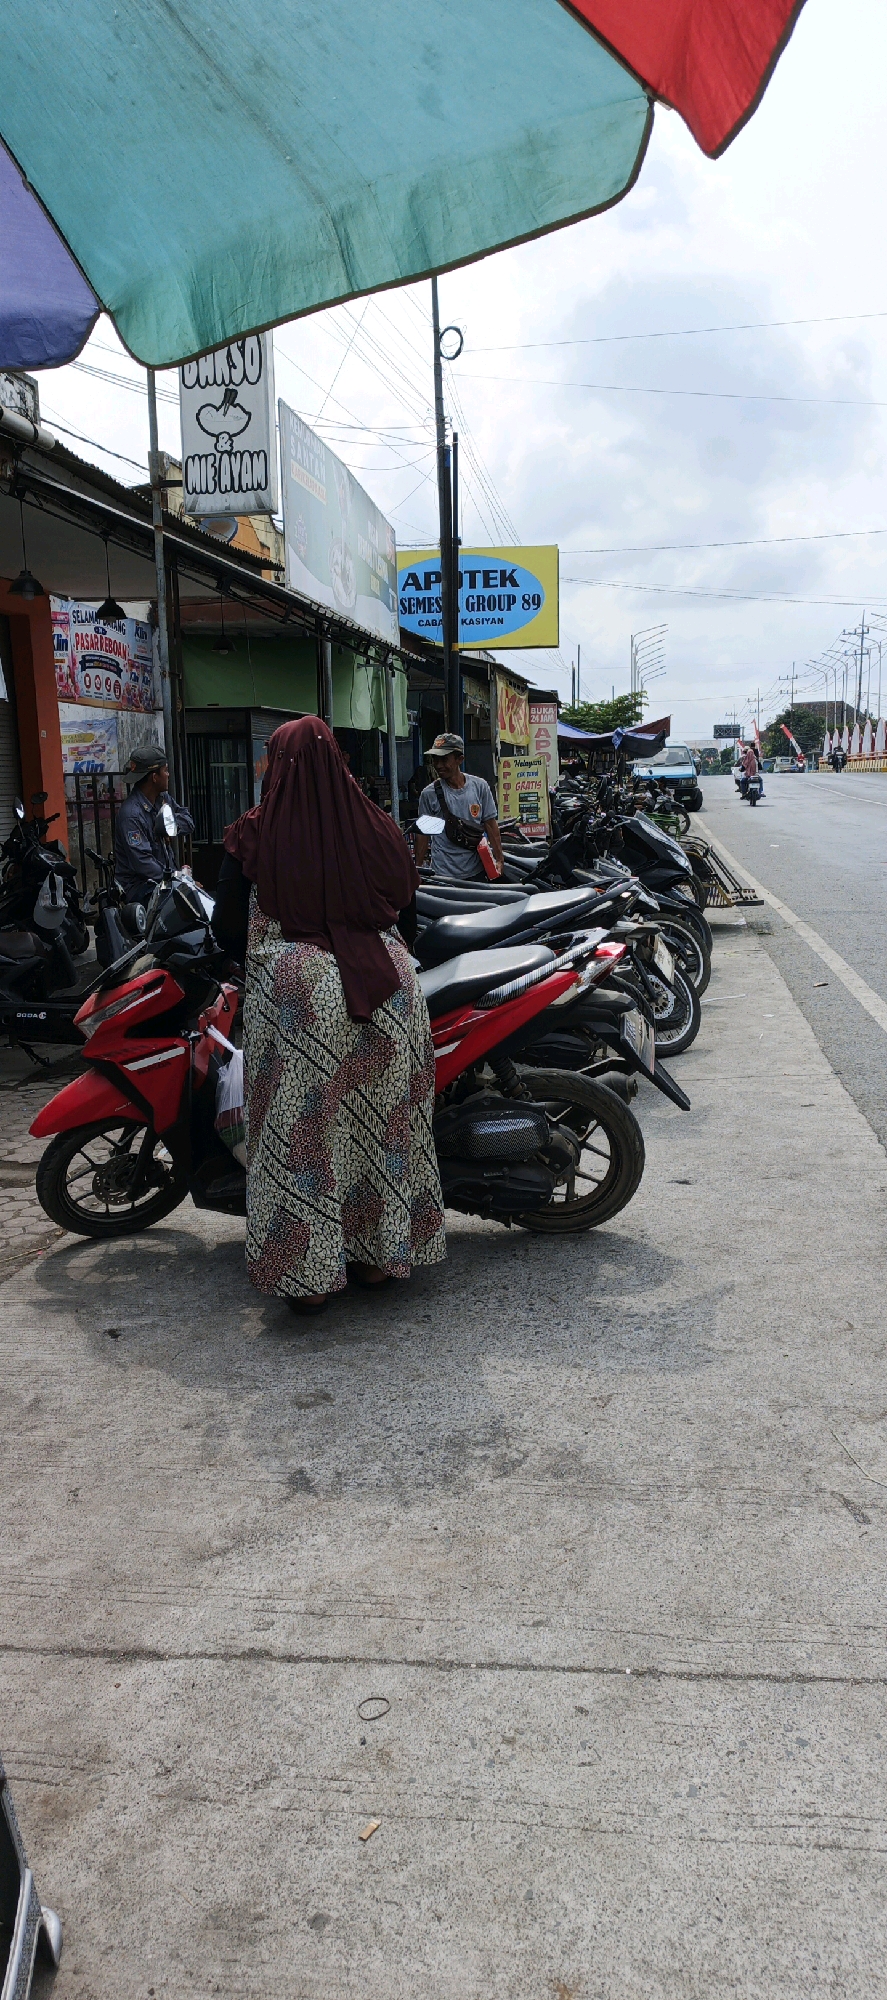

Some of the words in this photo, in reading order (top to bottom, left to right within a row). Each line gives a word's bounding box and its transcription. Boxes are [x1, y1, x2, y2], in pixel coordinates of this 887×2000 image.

[214, 431, 234, 453] &
[185, 453, 217, 495] MIE
[218, 450, 268, 494] AYAM
[401, 568, 520, 592] APTEK
[400, 596, 461, 615] SEMES
[465, 594, 517, 612] GROUP
[521, 593, 542, 611] 89
[461, 617, 504, 626] KASIYAN
[75, 632, 99, 651] PASAR
[100, 634, 127, 661] REBOAN
[530, 714, 539, 723] 24
[540, 714, 555, 723] JAM
[515, 780, 542, 792] GRATIS
